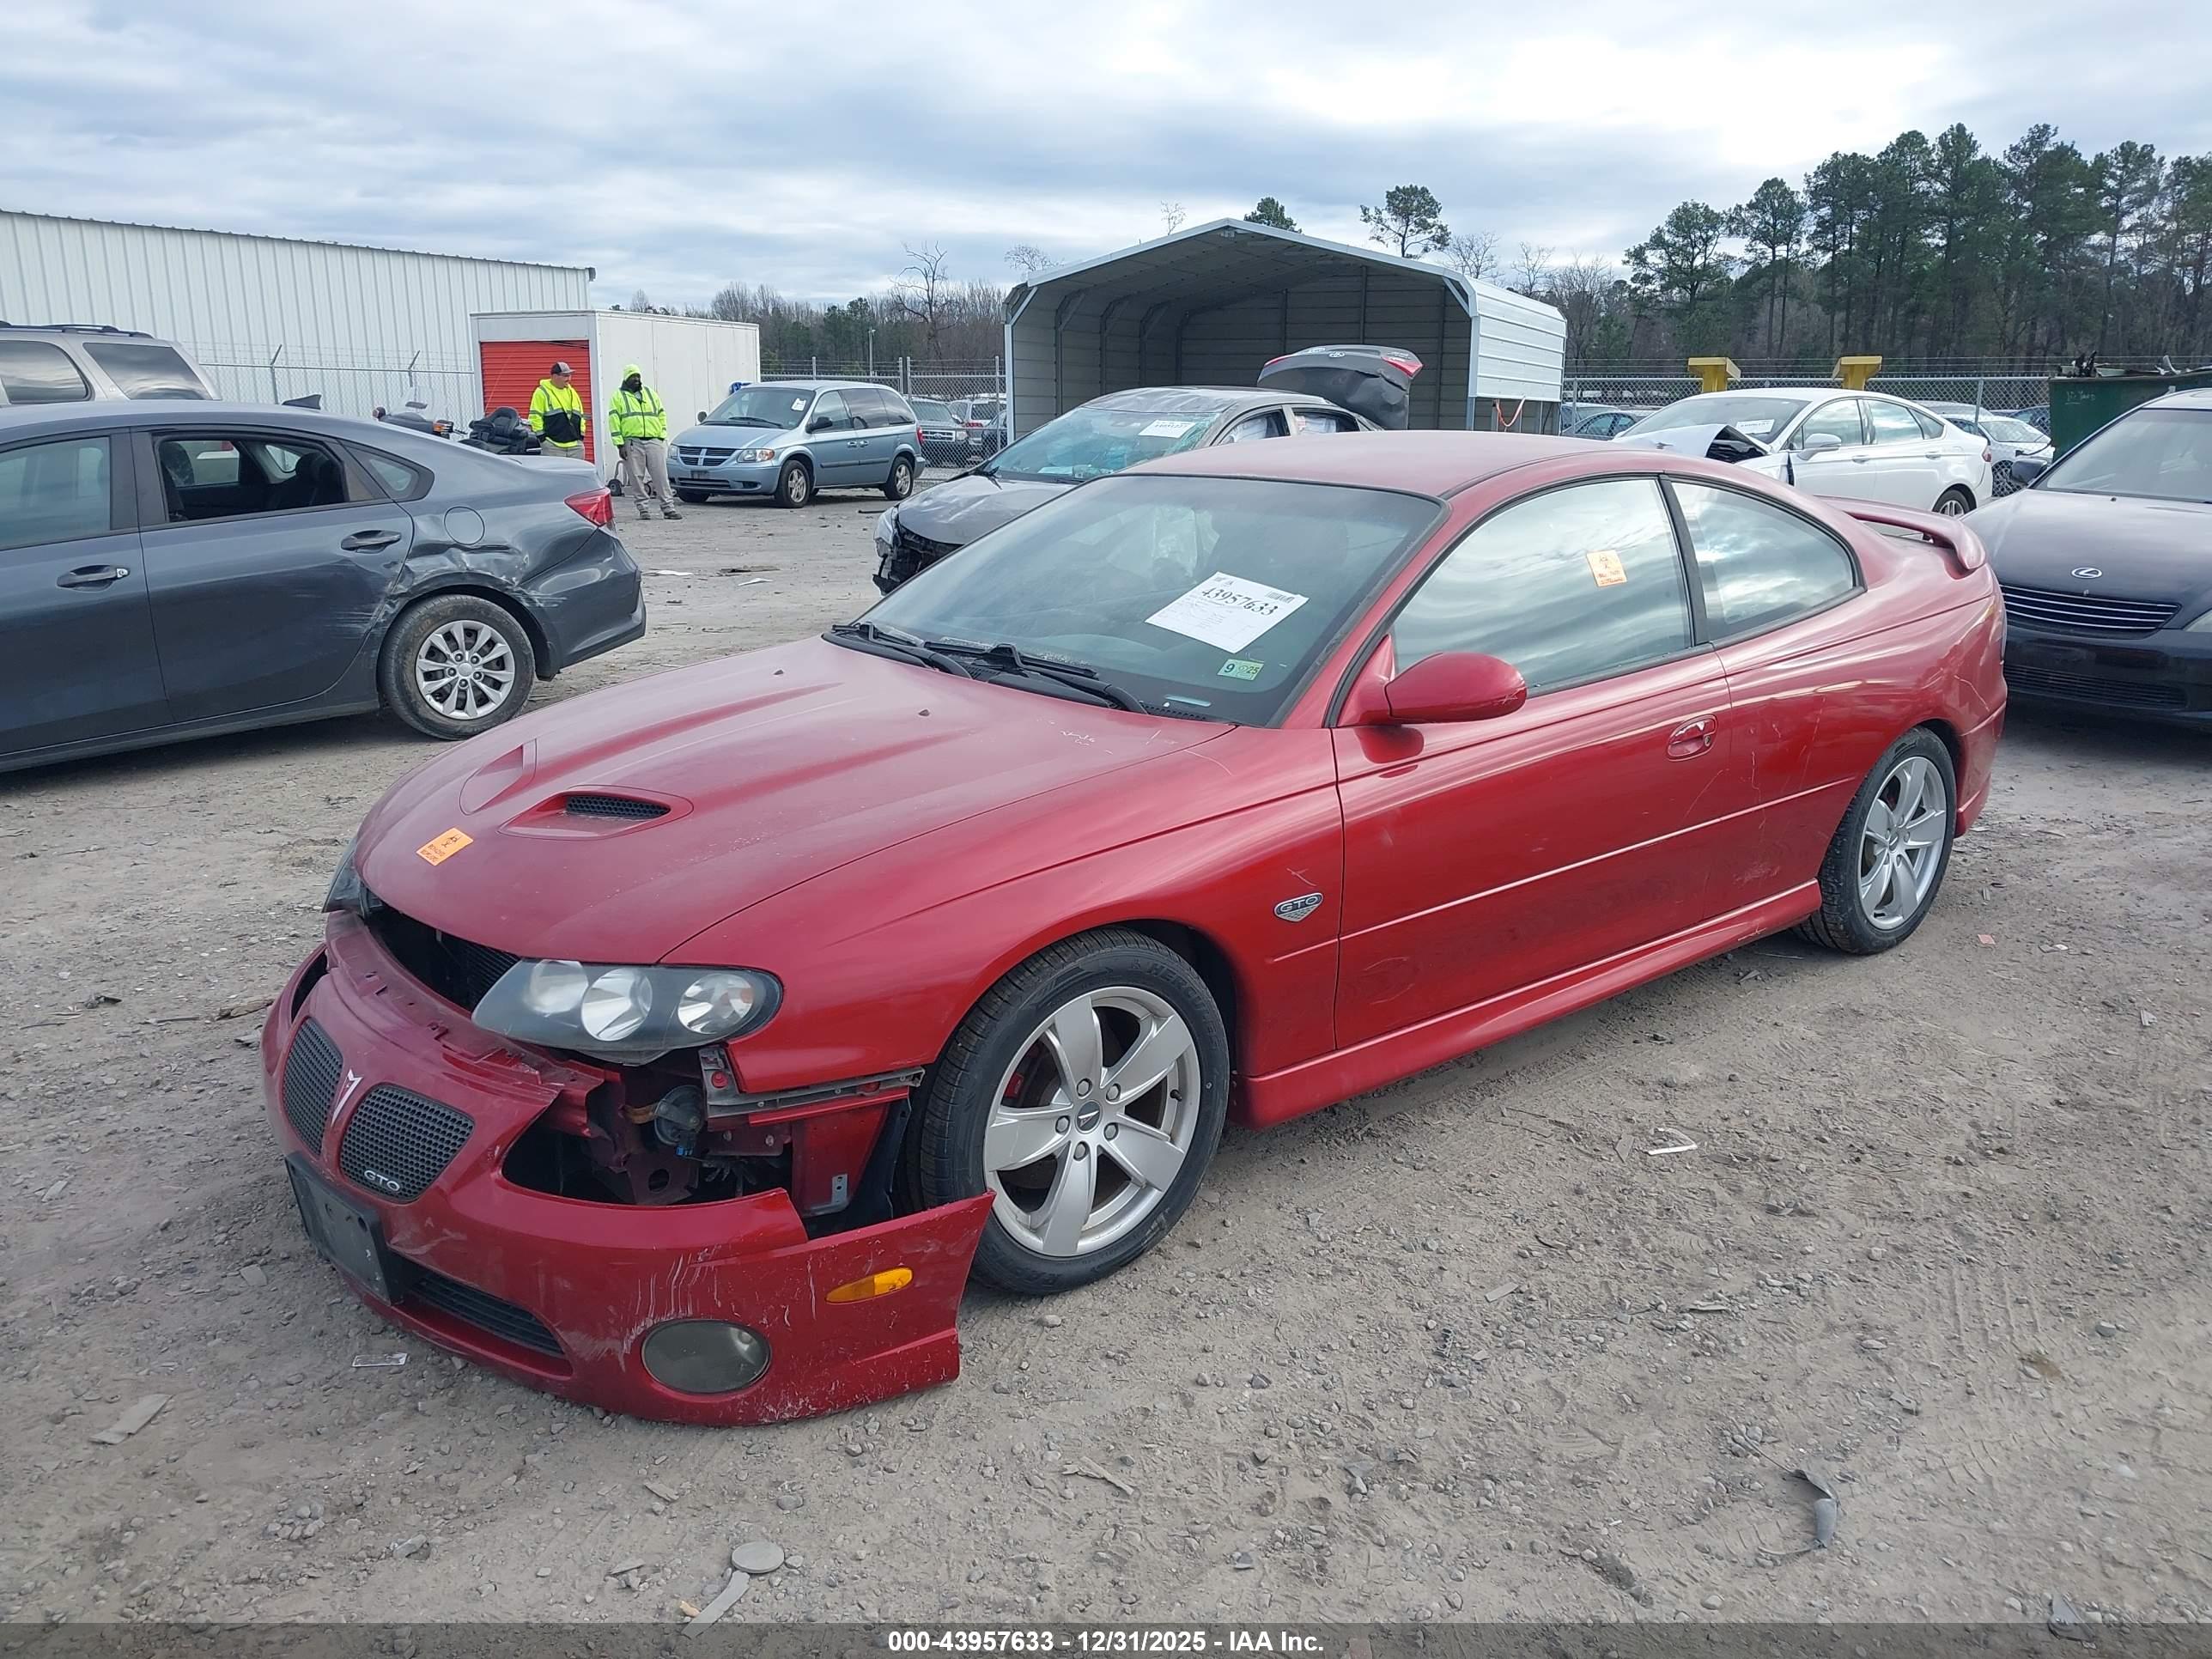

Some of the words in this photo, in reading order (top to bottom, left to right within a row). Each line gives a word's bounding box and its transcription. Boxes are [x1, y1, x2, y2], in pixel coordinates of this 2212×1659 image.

[1202, 587, 1279, 616] 43957633
[1224, 663, 1235, 673] 9
[1246, 665, 1260, 675] 25
[1280, 896, 1318, 912] GTO
[364, 1170, 400, 1192] GTO
